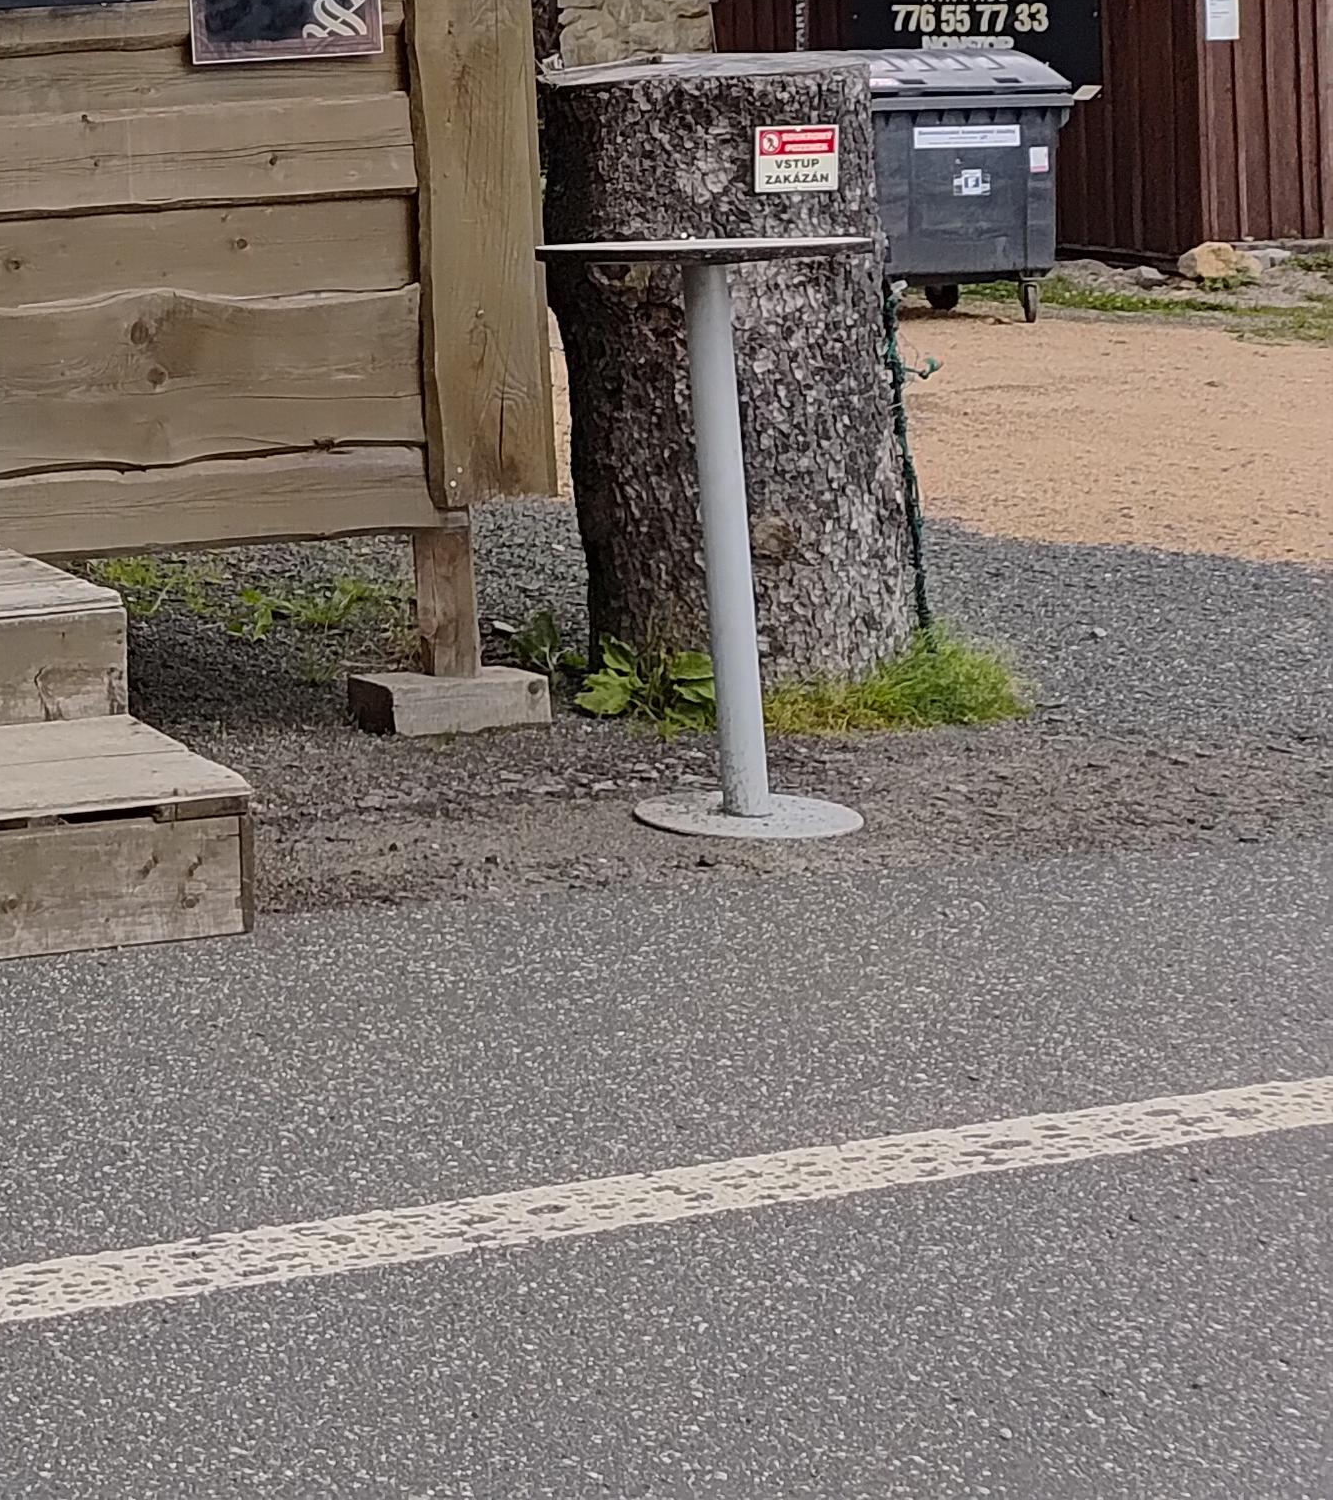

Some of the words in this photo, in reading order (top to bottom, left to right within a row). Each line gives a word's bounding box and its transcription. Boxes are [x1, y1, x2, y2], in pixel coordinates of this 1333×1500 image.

[891, 4, 935, 32] 776
[940, 4, 971, 33] 55
[975, 3, 1009, 32] 77
[1013, 2, 1049, 32] 33
[775, 158, 820, 169] VSTUP
[765, 172, 830, 185] ZAKÁZÁN
